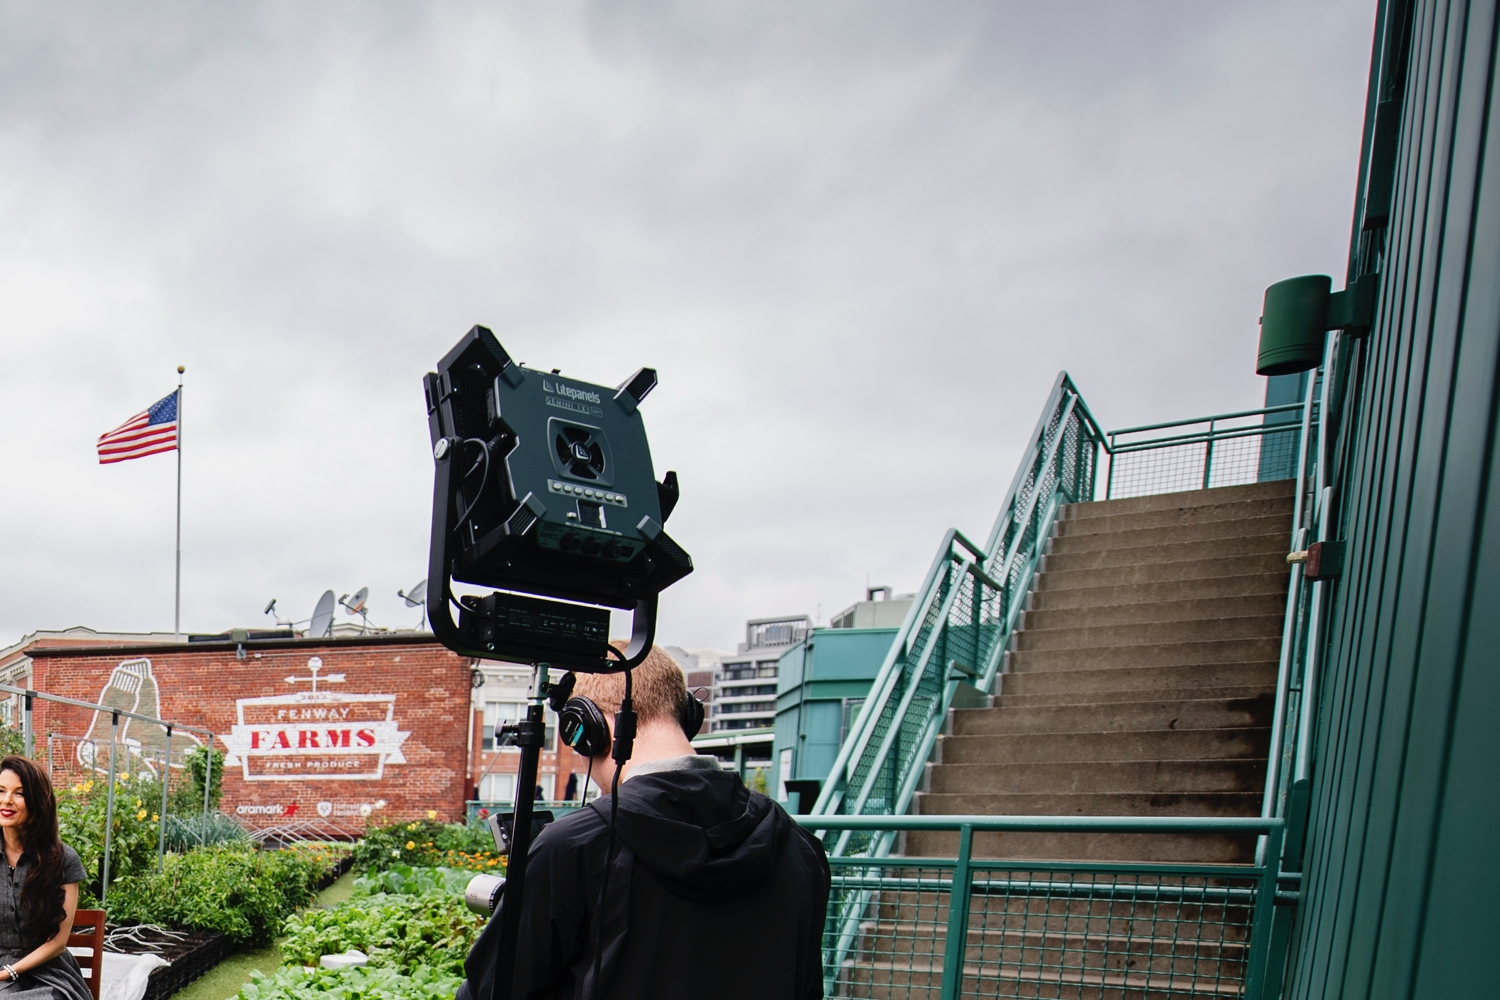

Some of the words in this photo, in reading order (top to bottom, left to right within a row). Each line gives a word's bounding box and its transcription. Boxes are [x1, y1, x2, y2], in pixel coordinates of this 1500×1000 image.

[555, 382, 601, 404] Litepanels
[277, 708, 350, 719] FENWAY
[251, 729, 376, 749] FARMS
[266, 761, 301, 769] FRESH
[306, 760, 360, 768] PRODUCE
[236, 803, 283, 814] aramark
